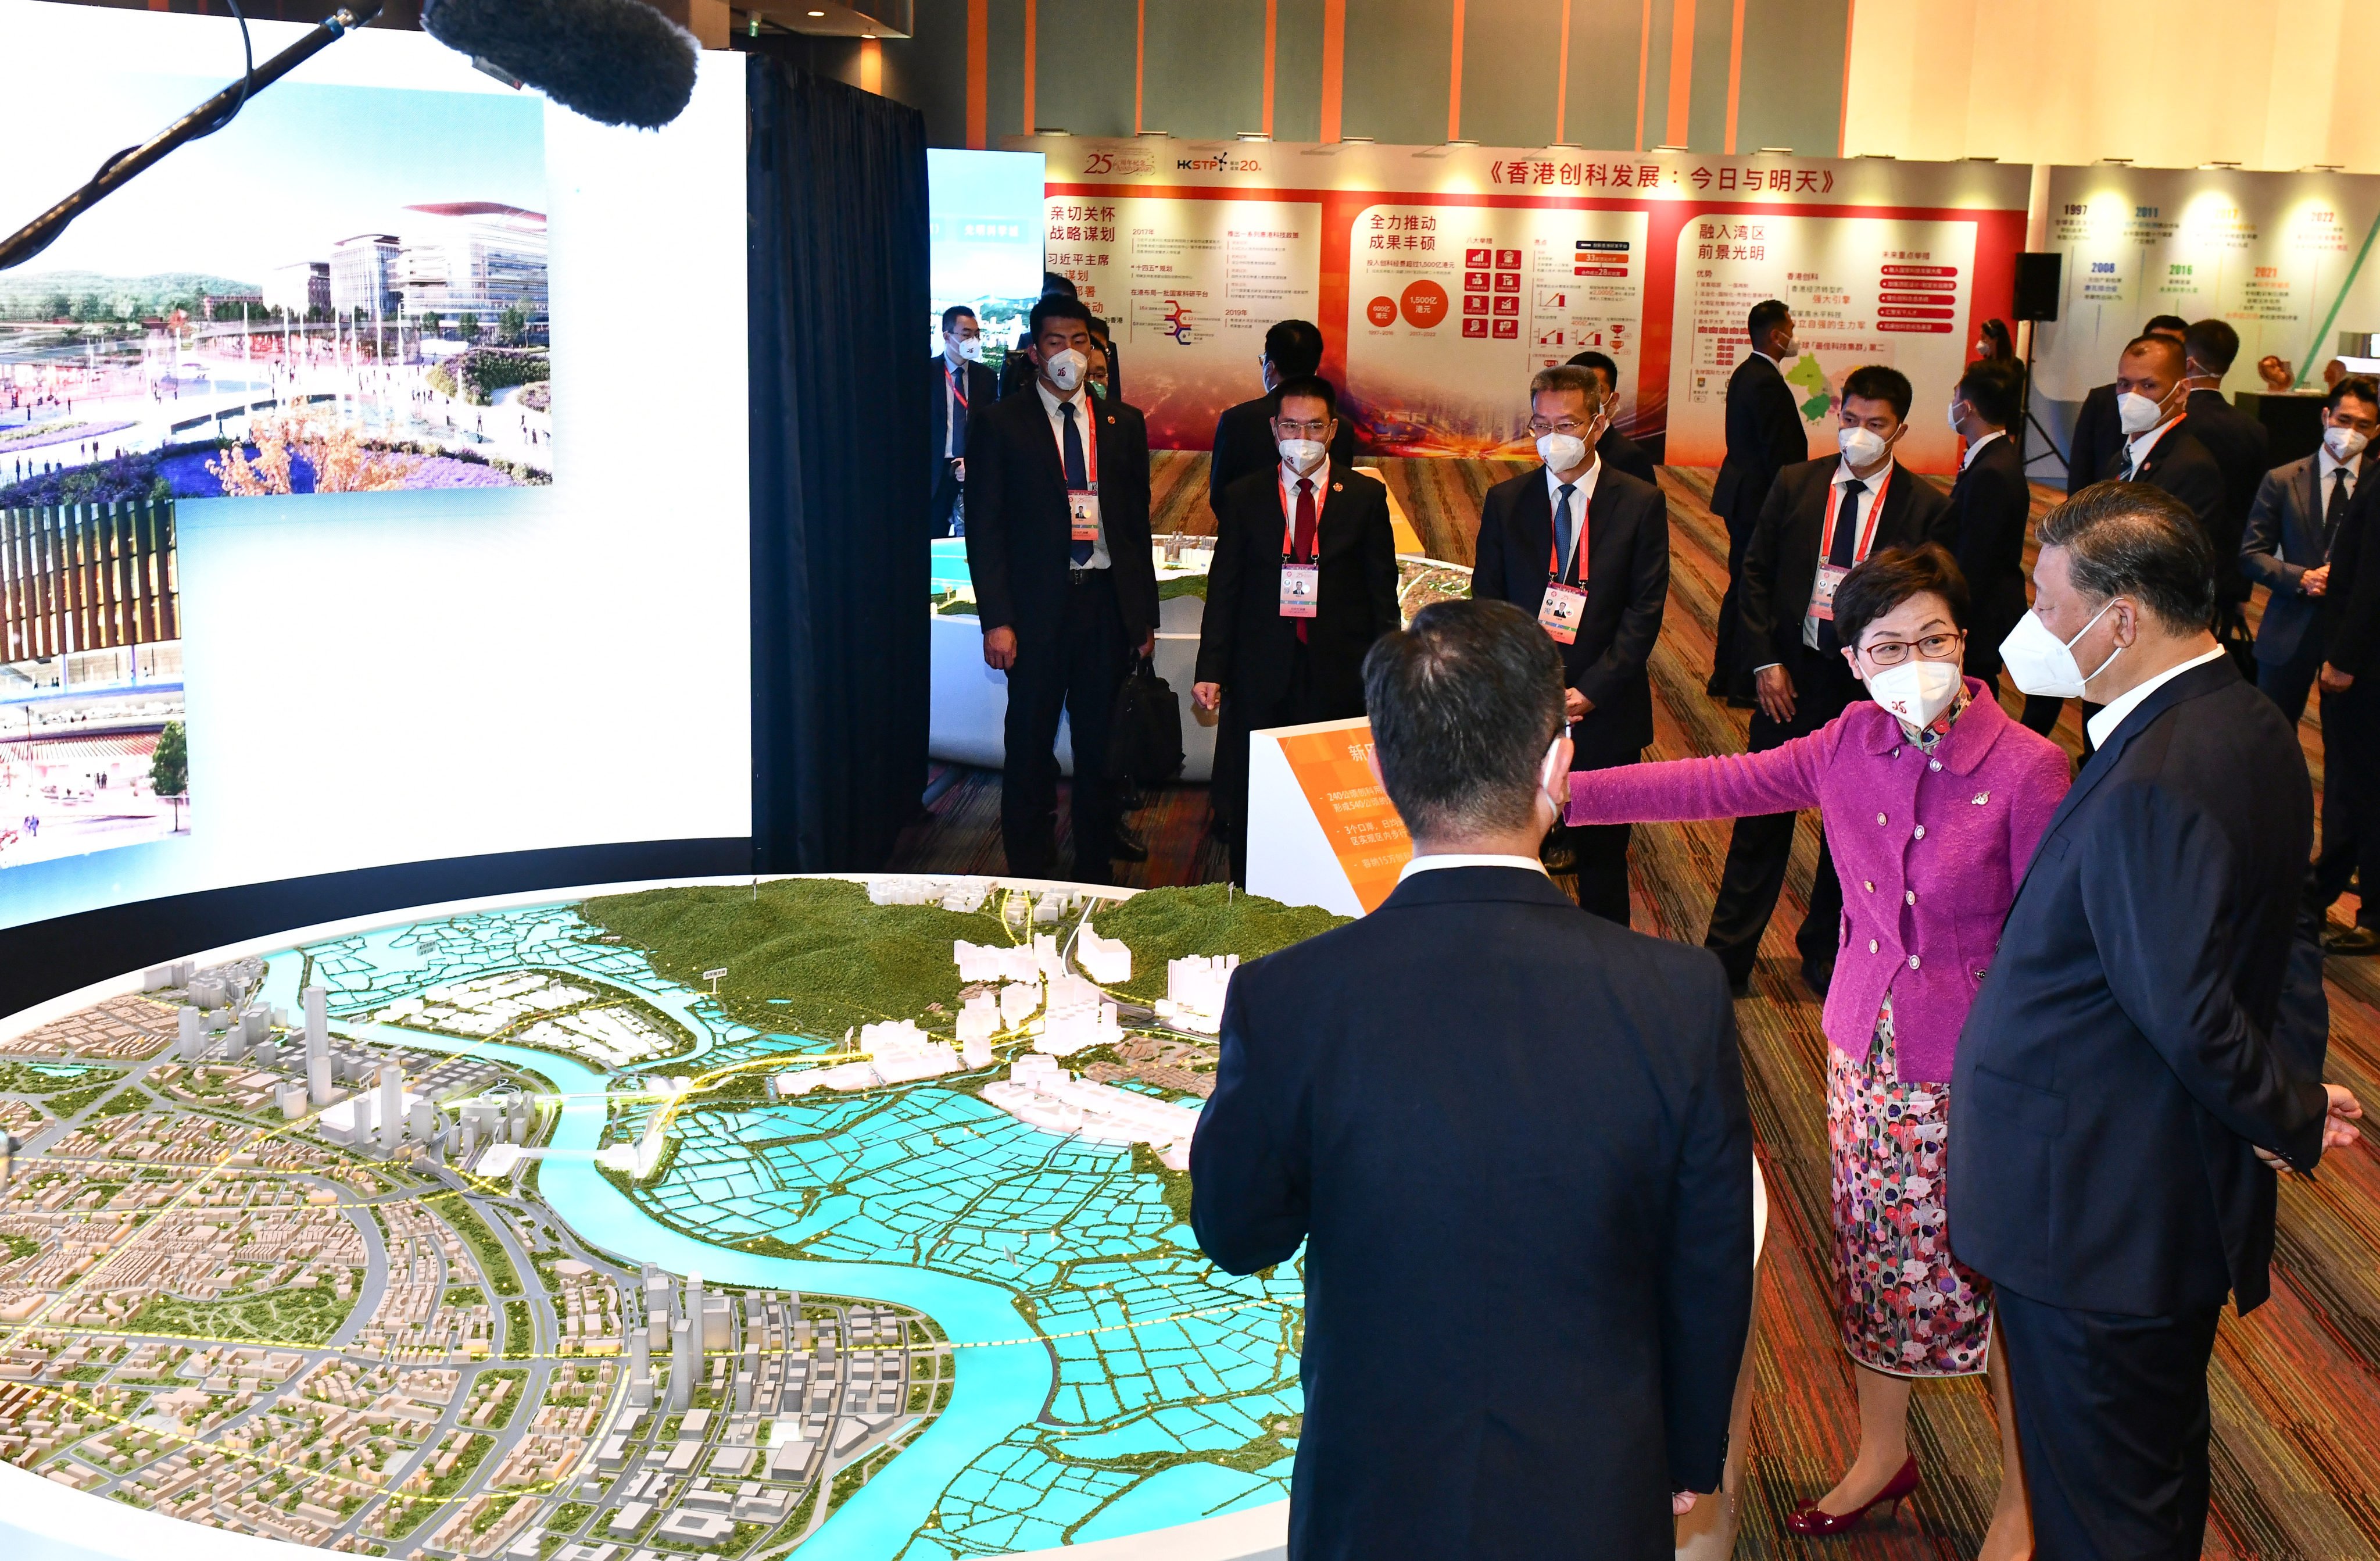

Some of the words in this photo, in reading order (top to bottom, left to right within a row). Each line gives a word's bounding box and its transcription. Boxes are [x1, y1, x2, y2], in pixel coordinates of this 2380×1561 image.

[1084, 153, 1114, 174] 25
[1177, 159, 1218, 170] HKSTP
[1491, 160, 1834, 194] 《香港创科发展：今日与明天》
[1050, 206, 1115, 222] 亲切关怀
[2064, 205, 2087, 215] 1997
[2135, 206, 2159, 217] 2011
[2311, 212, 2335, 222] 2022
[1370, 215, 1436, 231] 全力推动
[1050, 226, 1115, 242] 战略谋划
[1698, 223, 1766, 241] 融入湾区
[1369, 235, 1436, 251] 成果丰硕
[1698, 244, 1765, 260] 前景光明
[1047, 253, 1110, 266] 习近平主席
[1697, 269, 1712, 278] 优势
[2169, 265, 2192, 275] 2016
[2254, 267, 2277, 278] 2021
[1787, 273, 1819, 281] 香港创科
[1130, 289, 1208, 297] 在港布局一批国家科研平台
[1409, 297, 1437, 305] 1,500亿
[1813, 294, 1851, 305] 强大引擎
[1415, 305, 1431, 313] 港元
[1057, 367, 1066, 377] 25
[1891, 700, 1907, 714] 25
